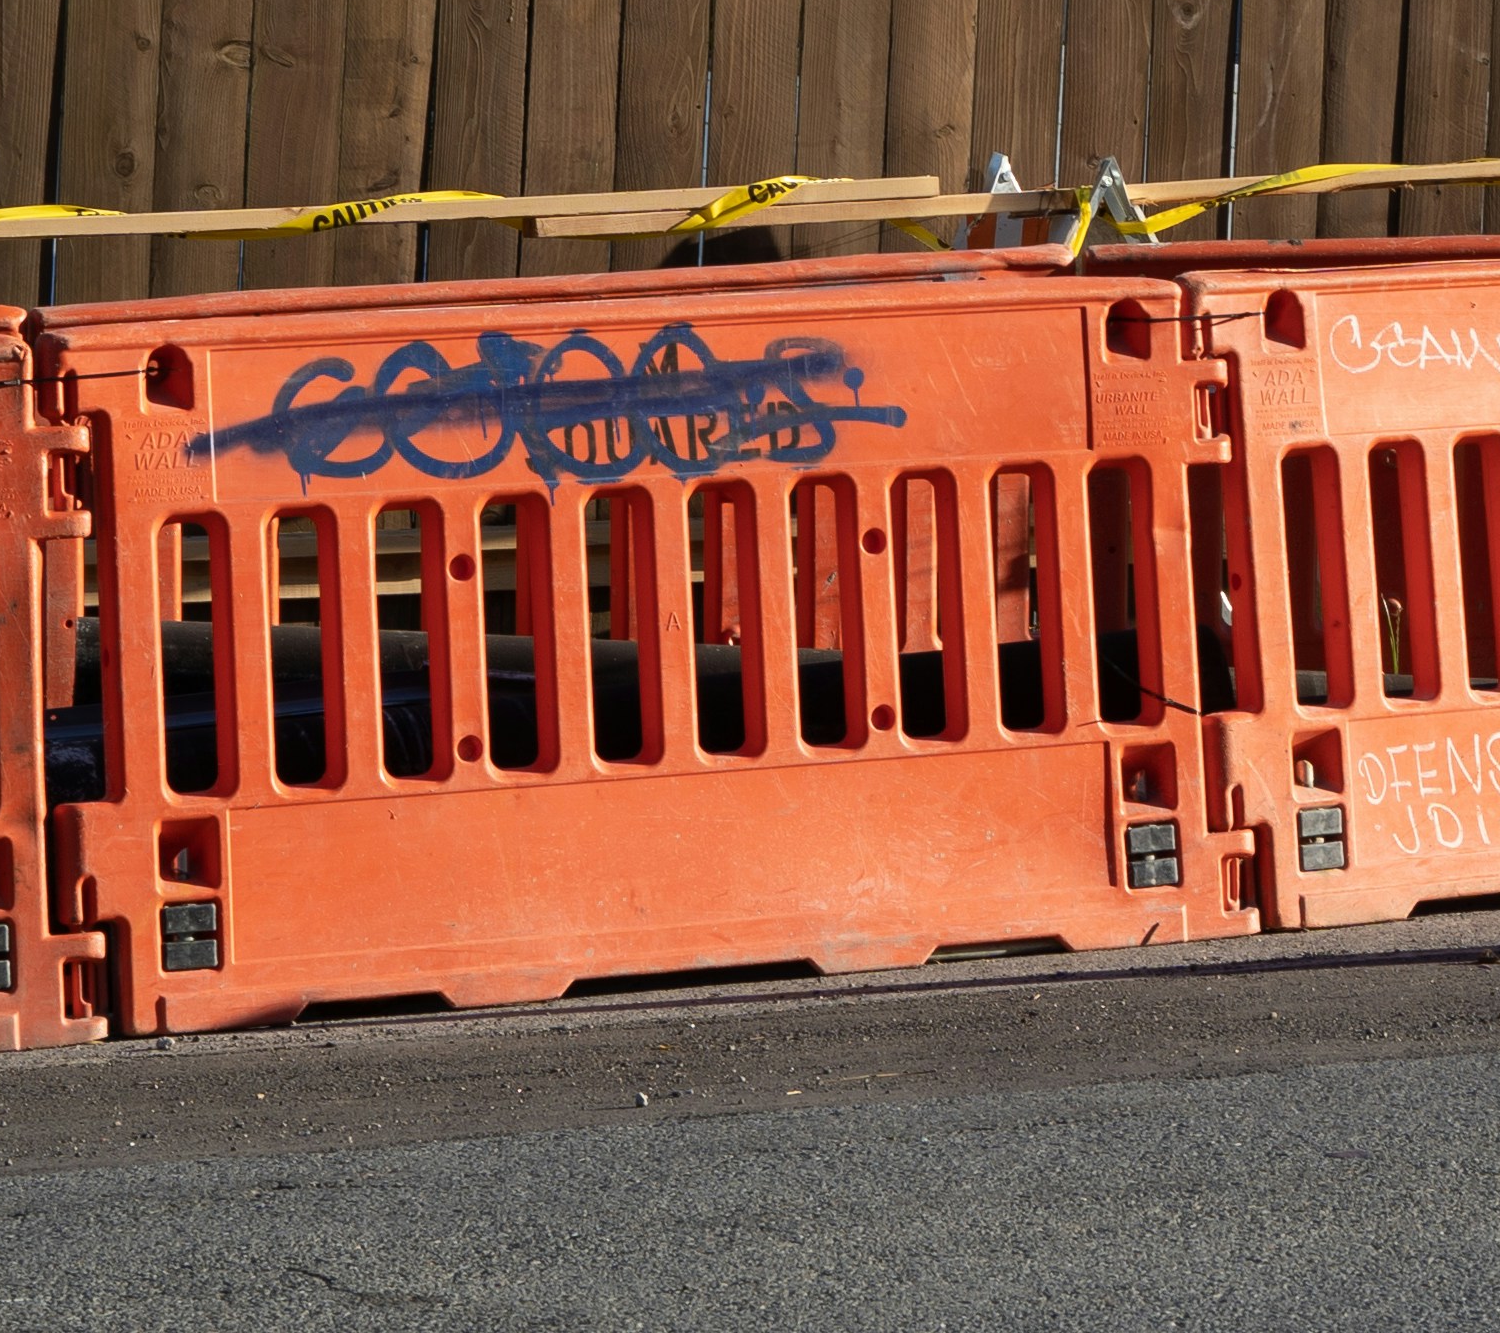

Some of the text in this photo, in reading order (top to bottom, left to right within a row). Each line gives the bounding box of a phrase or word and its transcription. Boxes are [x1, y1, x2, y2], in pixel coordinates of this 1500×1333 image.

[1263, 368, 1304, 387] ADA
[1095, 391, 1159, 404] URBANITE
[1260, 386, 1312, 406] WALL
[1115, 404, 1150, 415] WALL
[1261, 421, 1286, 431] MADE
[140, 430, 191, 451] ADA
[1102, 431, 1131, 441] MADE
[1144, 429, 1163, 439] USA
[134, 449, 200, 471] WALL
[135, 484, 201, 498] MADE IN USA
[666, 612, 682, 632] A
